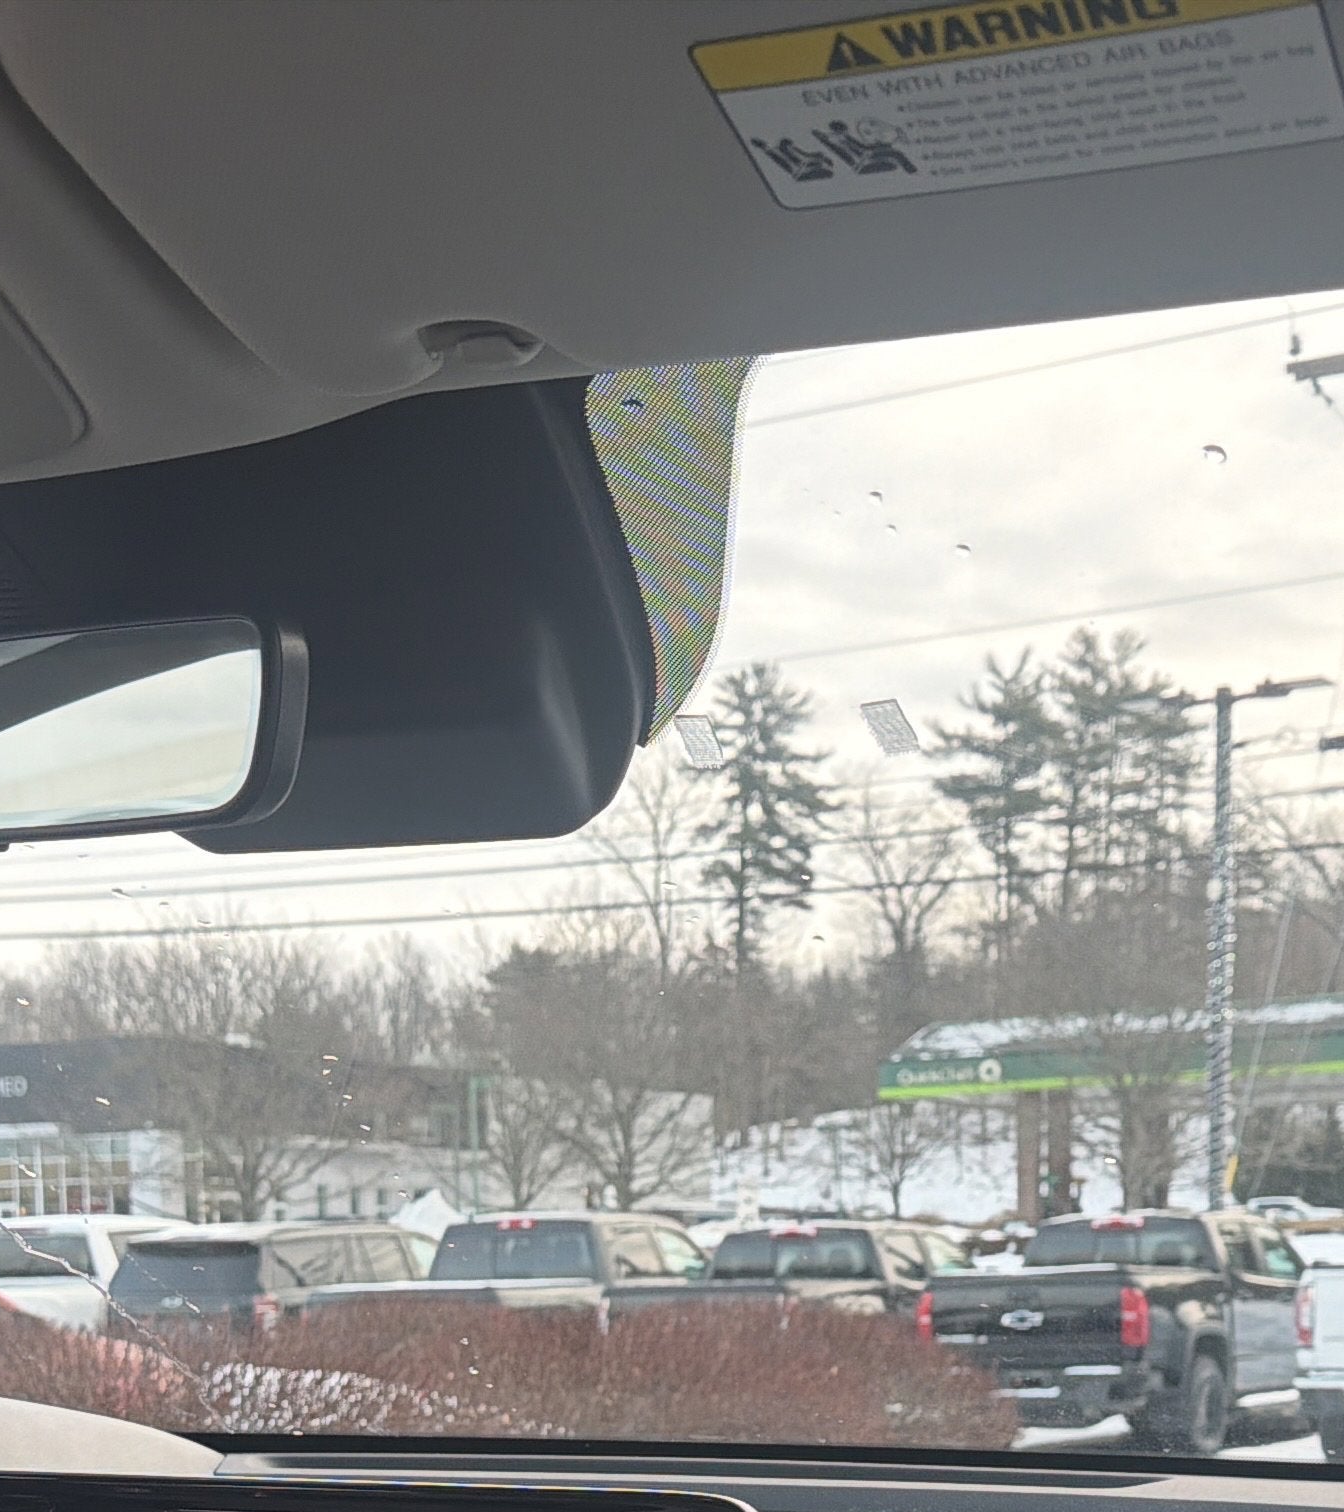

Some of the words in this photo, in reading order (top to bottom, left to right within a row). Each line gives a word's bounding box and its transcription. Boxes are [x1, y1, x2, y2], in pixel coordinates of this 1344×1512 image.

[801, 80, 870, 107] EVEN
[877, 70, 944, 97] WITH
[955, 49, 1091, 86] ADVANCED
[1105, 42, 1147, 62] AIR
[1159, 27, 1234, 55] BAGS
